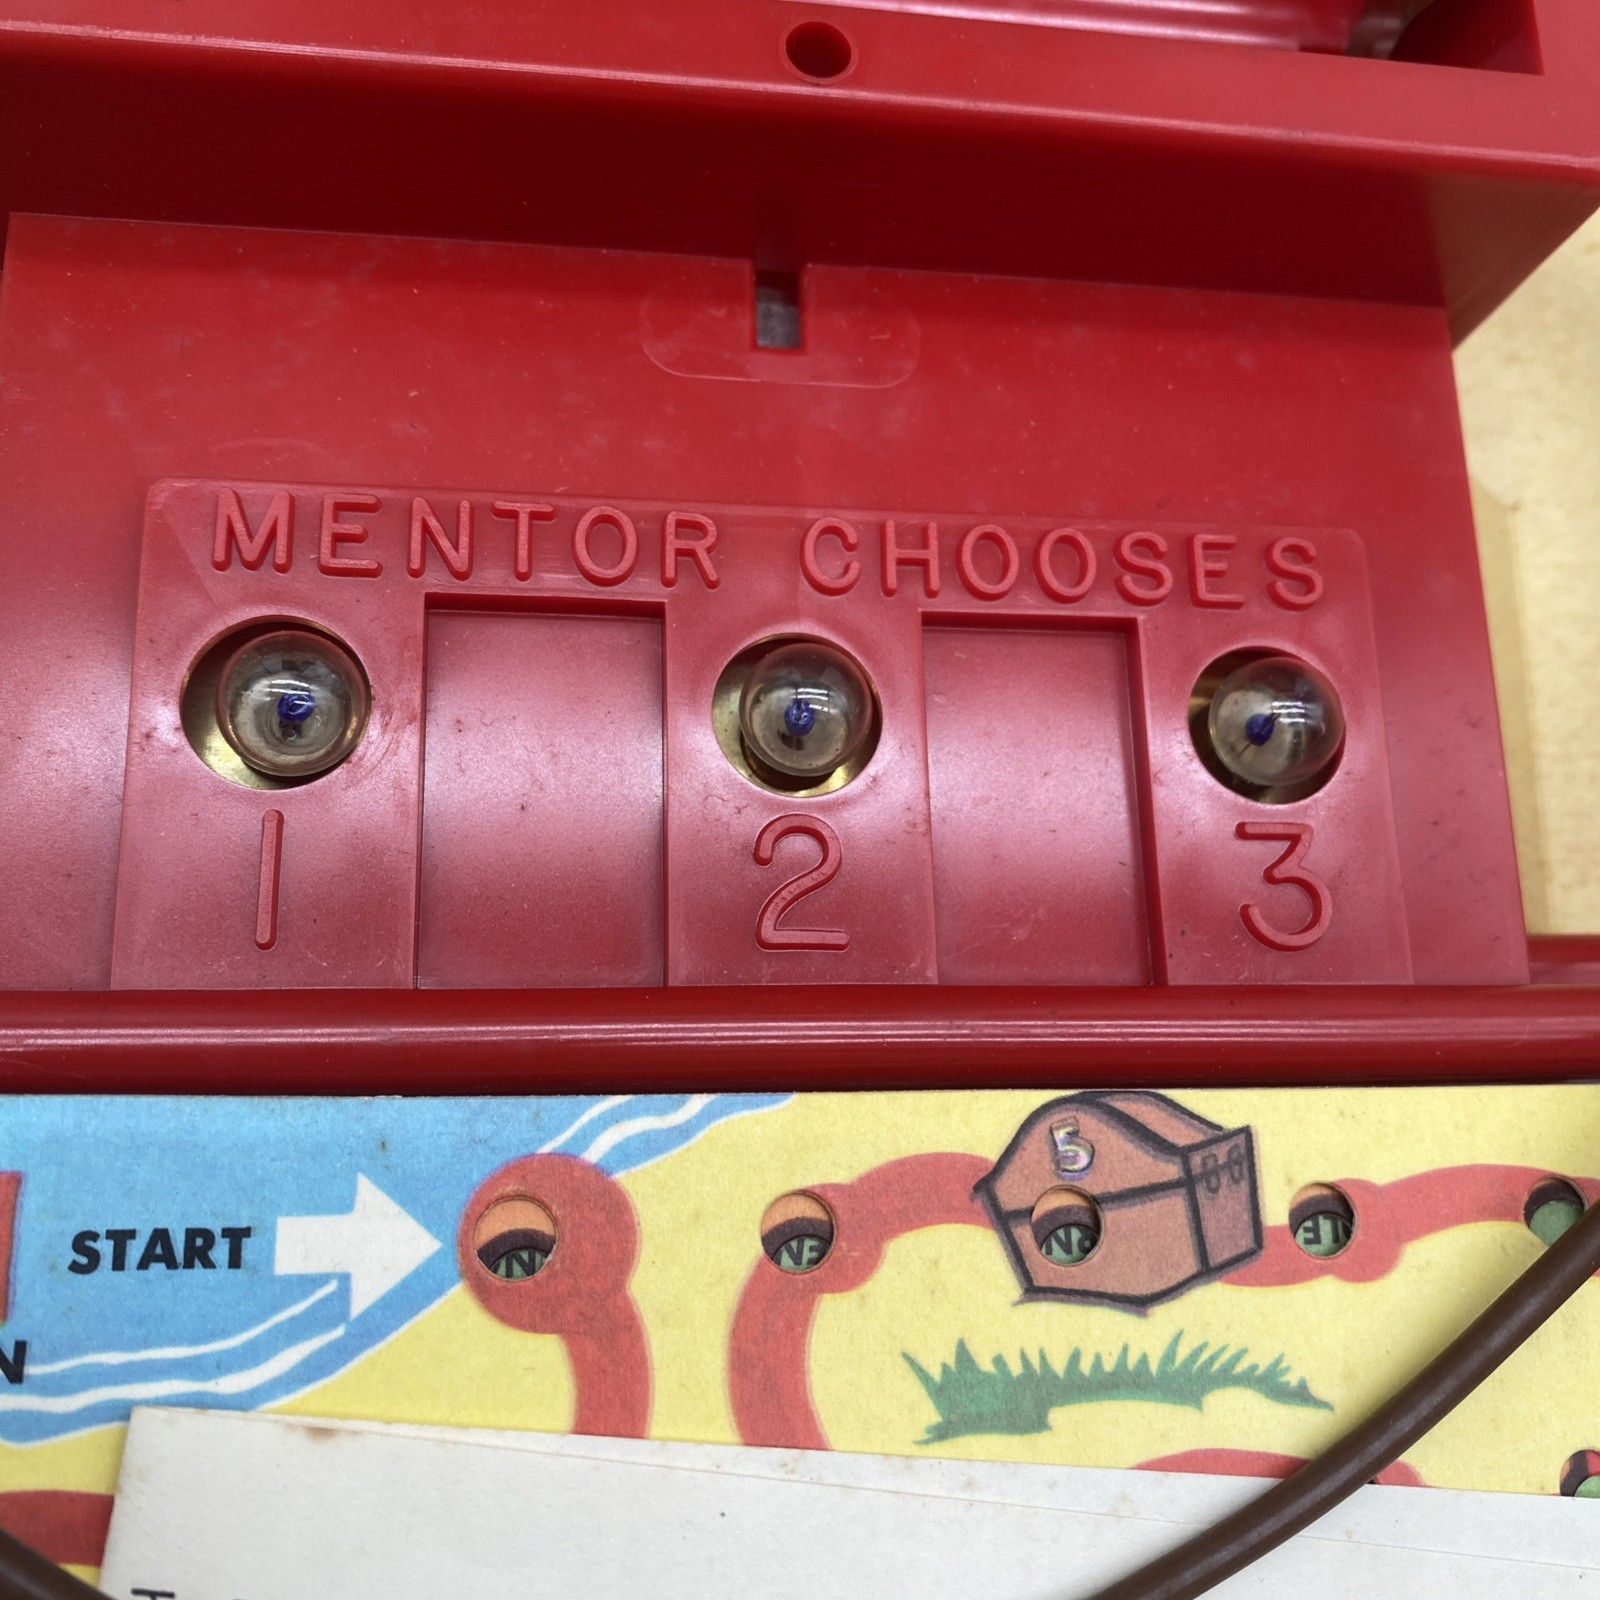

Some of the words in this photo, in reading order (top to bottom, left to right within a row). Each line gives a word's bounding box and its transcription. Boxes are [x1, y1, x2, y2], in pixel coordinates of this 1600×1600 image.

[212, 487, 720, 590] MENTOR
[800, 516, 1325, 609] CHOOSES
[254, 808, 285, 950] 1
[753, 812, 850, 952] 2
[1235, 820, 1334, 951] 3
[1048, 1116, 1096, 1180] 5
[67, 1226, 252, 1275] START
